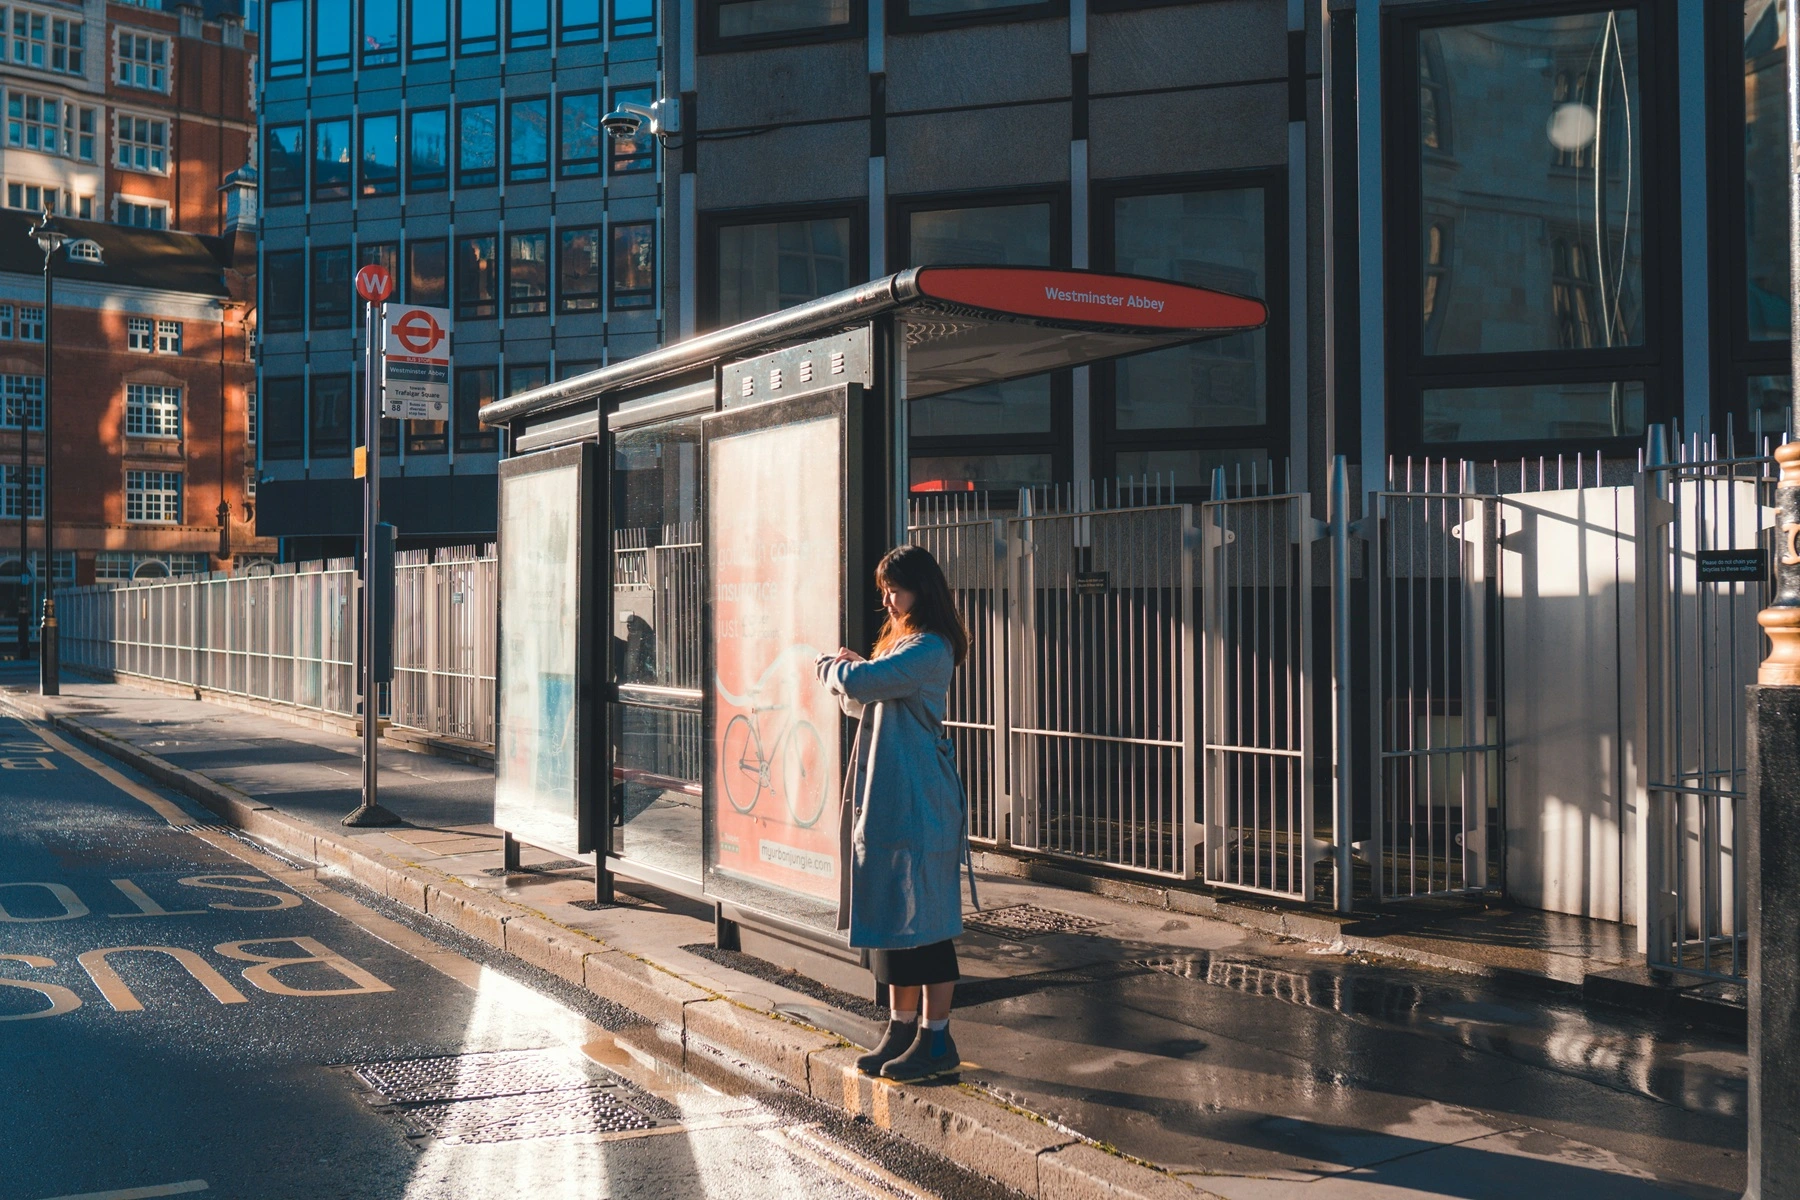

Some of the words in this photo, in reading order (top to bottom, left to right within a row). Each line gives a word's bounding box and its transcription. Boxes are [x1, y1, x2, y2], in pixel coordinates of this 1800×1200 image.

[362, 272, 388, 294] W
[1045, 286, 1123, 306] Westminster
[1127, 295, 1164, 312] Abbey
[389, 366, 426, 375] Westminster
[428, 370, 446, 378] Abbey
[395, 389, 420, 397] Trafalgar
[421, 391, 440, 399] Square
[391, 404, 401, 412] 88
[1746, 559, 1757, 567] your
[718, 579, 778, 601] insurance
[717, 614, 739, 643] just
[761, 844, 832, 872] myurbanjungle.com
[0, 936, 396, 1021] BUS
